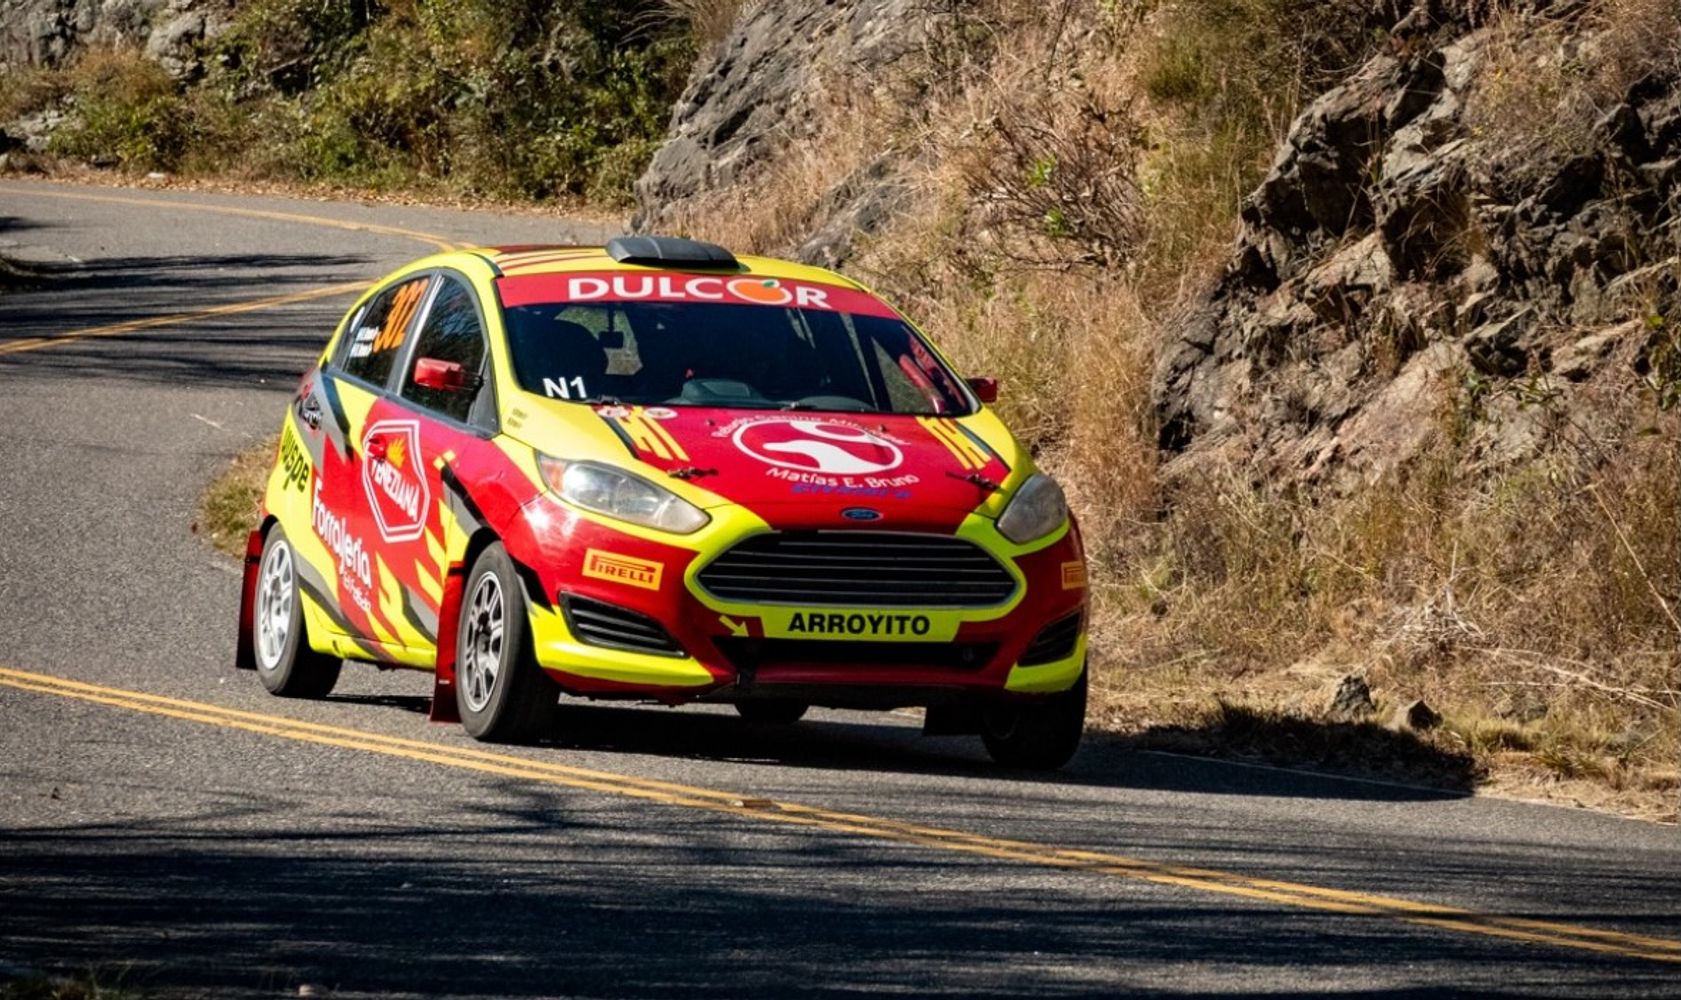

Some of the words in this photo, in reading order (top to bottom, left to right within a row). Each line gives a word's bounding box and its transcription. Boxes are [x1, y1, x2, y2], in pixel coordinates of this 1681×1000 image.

[569, 276, 832, 309] DULCOR
[372, 278, 429, 354] 302
[543, 377, 588, 402] N1
[766, 467, 839, 487] Matías
[843, 477, 863, 488] E.
[864, 474, 920, 488] Bruno
[589, 555, 656, 584] PIRELLI
[787, 612, 931, 636] ARROYITO
